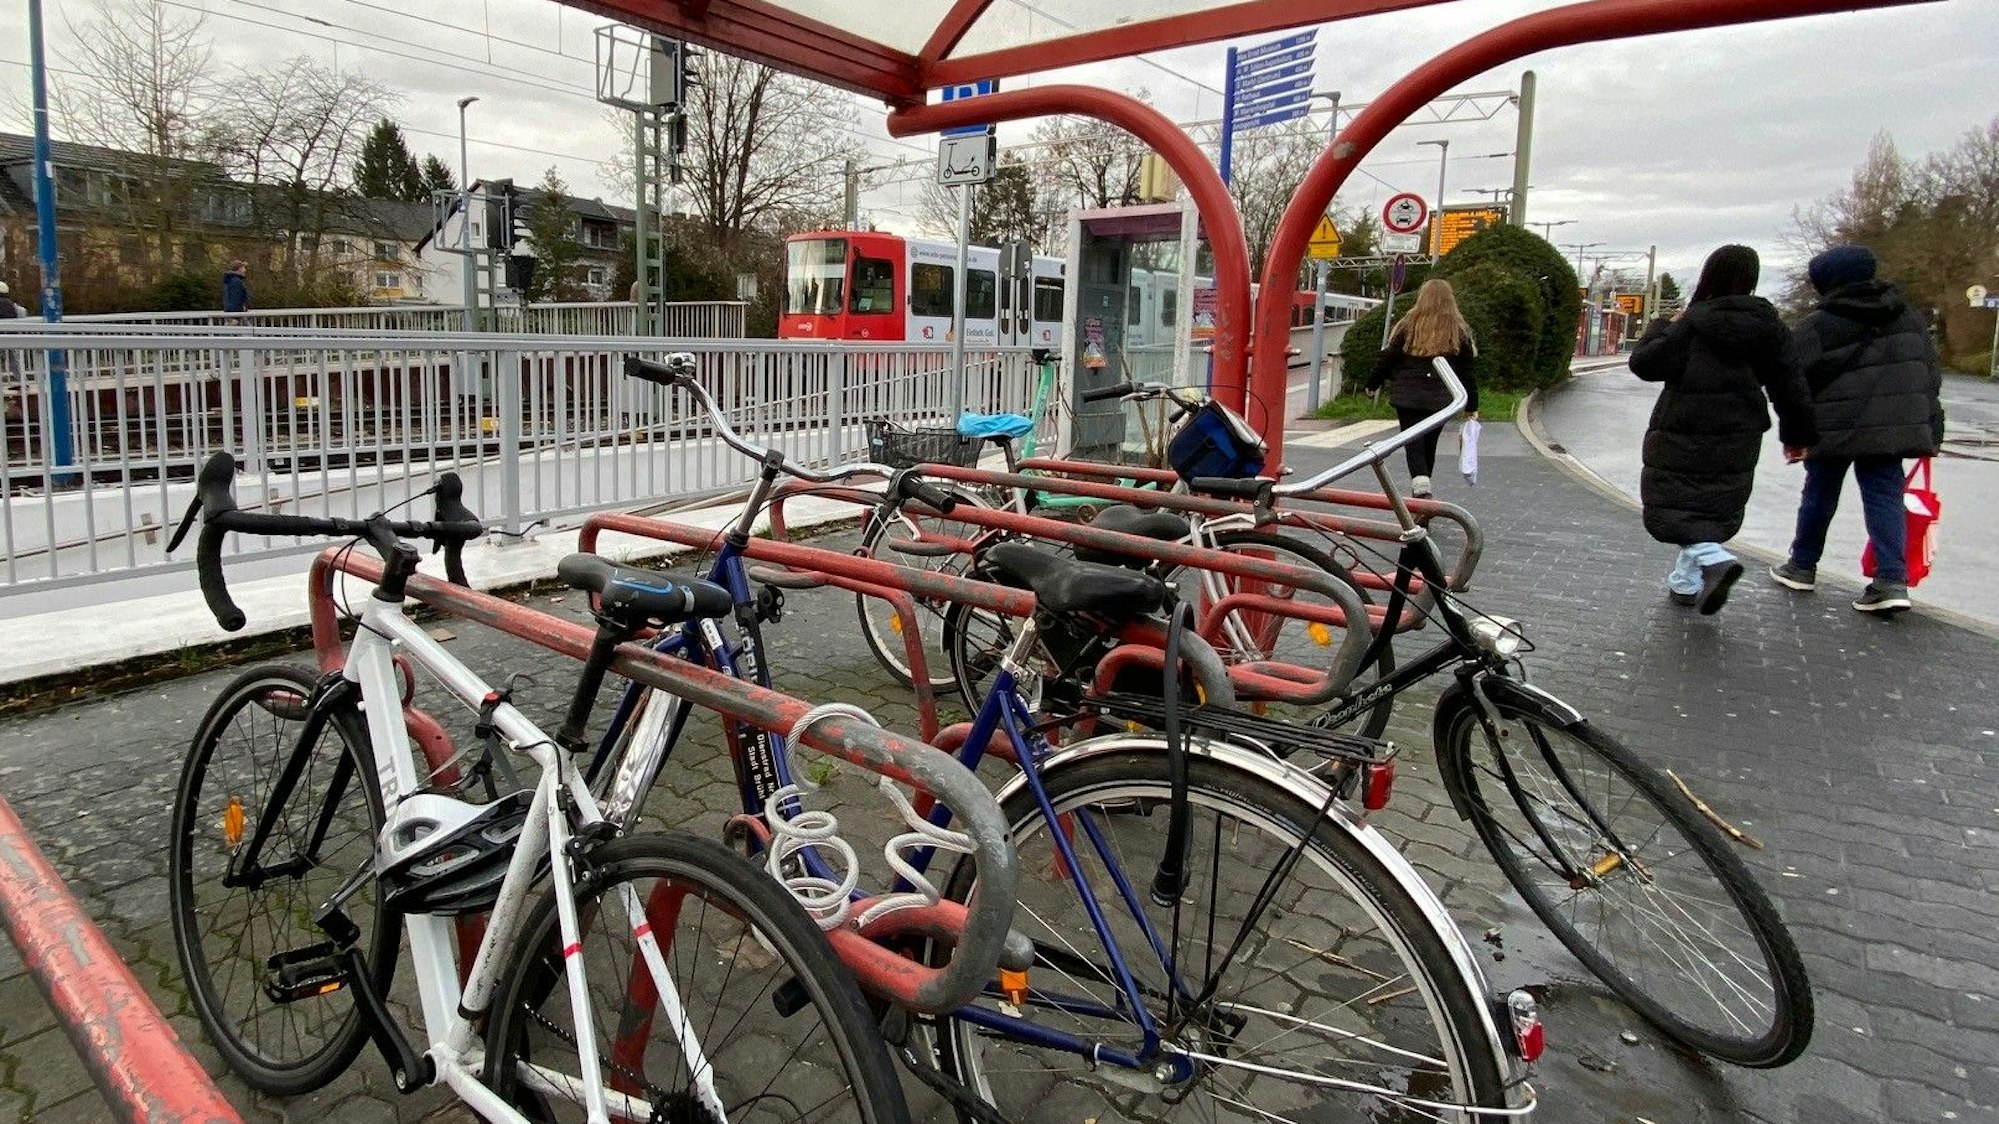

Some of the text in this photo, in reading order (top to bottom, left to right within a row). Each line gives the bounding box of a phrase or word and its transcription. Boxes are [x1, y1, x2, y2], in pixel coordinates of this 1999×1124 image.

[747, 745, 766, 799] Stadt Brühl
[756, 733, 773, 778] Dienstrad
